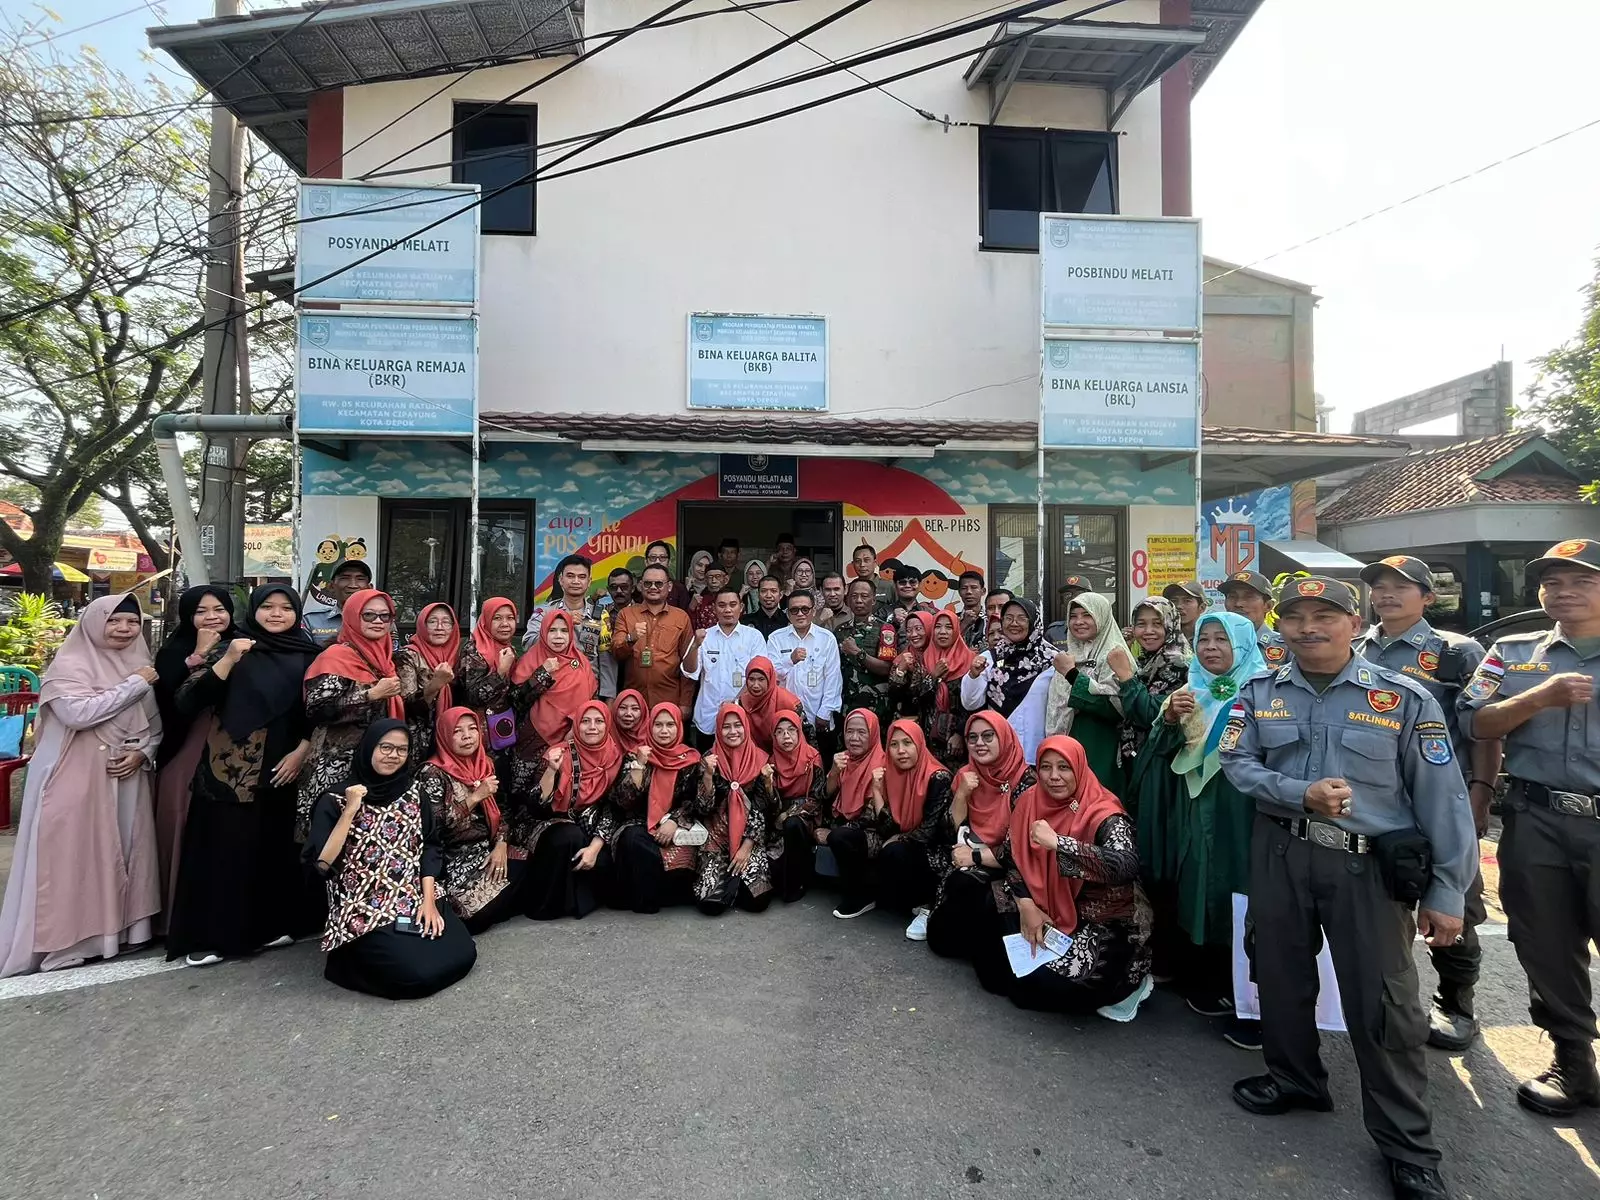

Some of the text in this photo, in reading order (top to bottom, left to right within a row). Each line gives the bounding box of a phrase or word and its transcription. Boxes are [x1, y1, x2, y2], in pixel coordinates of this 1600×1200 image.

[328, 237, 450, 252] POSYANDU MELATI
[1068, 267, 1174, 281] POSBINDU MELATI
[698, 350, 817, 362] BINA KELUARGA BALITA
[308, 358, 466, 373] BINA KELUARGA REMAJA
[743, 362, 772, 374] (BKB)
[369, 374, 406, 389] (BKR)
[1052, 379, 1188, 394] BINA KELUARGA LANSIA
[355, 401, 407, 409] KELURAHAN
[1105, 394, 1136, 408] (BKL)
[392, 411, 437, 419] CIPAYUNG
[360, 418, 415, 427] KOTA DEPOK
[723, 475, 793, 483] POSYANDU MELATI A&B
[843, 519, 872, 532] RUMAH
[874, 519, 904, 533] TANGGA
[243, 542, 262, 551] SOLO
[544, 534, 578, 555] POS
[1210, 523, 1256, 577] MG
[1132, 550, 1148, 588] 8
[1348, 711, 1401, 730] SATLINMAS
